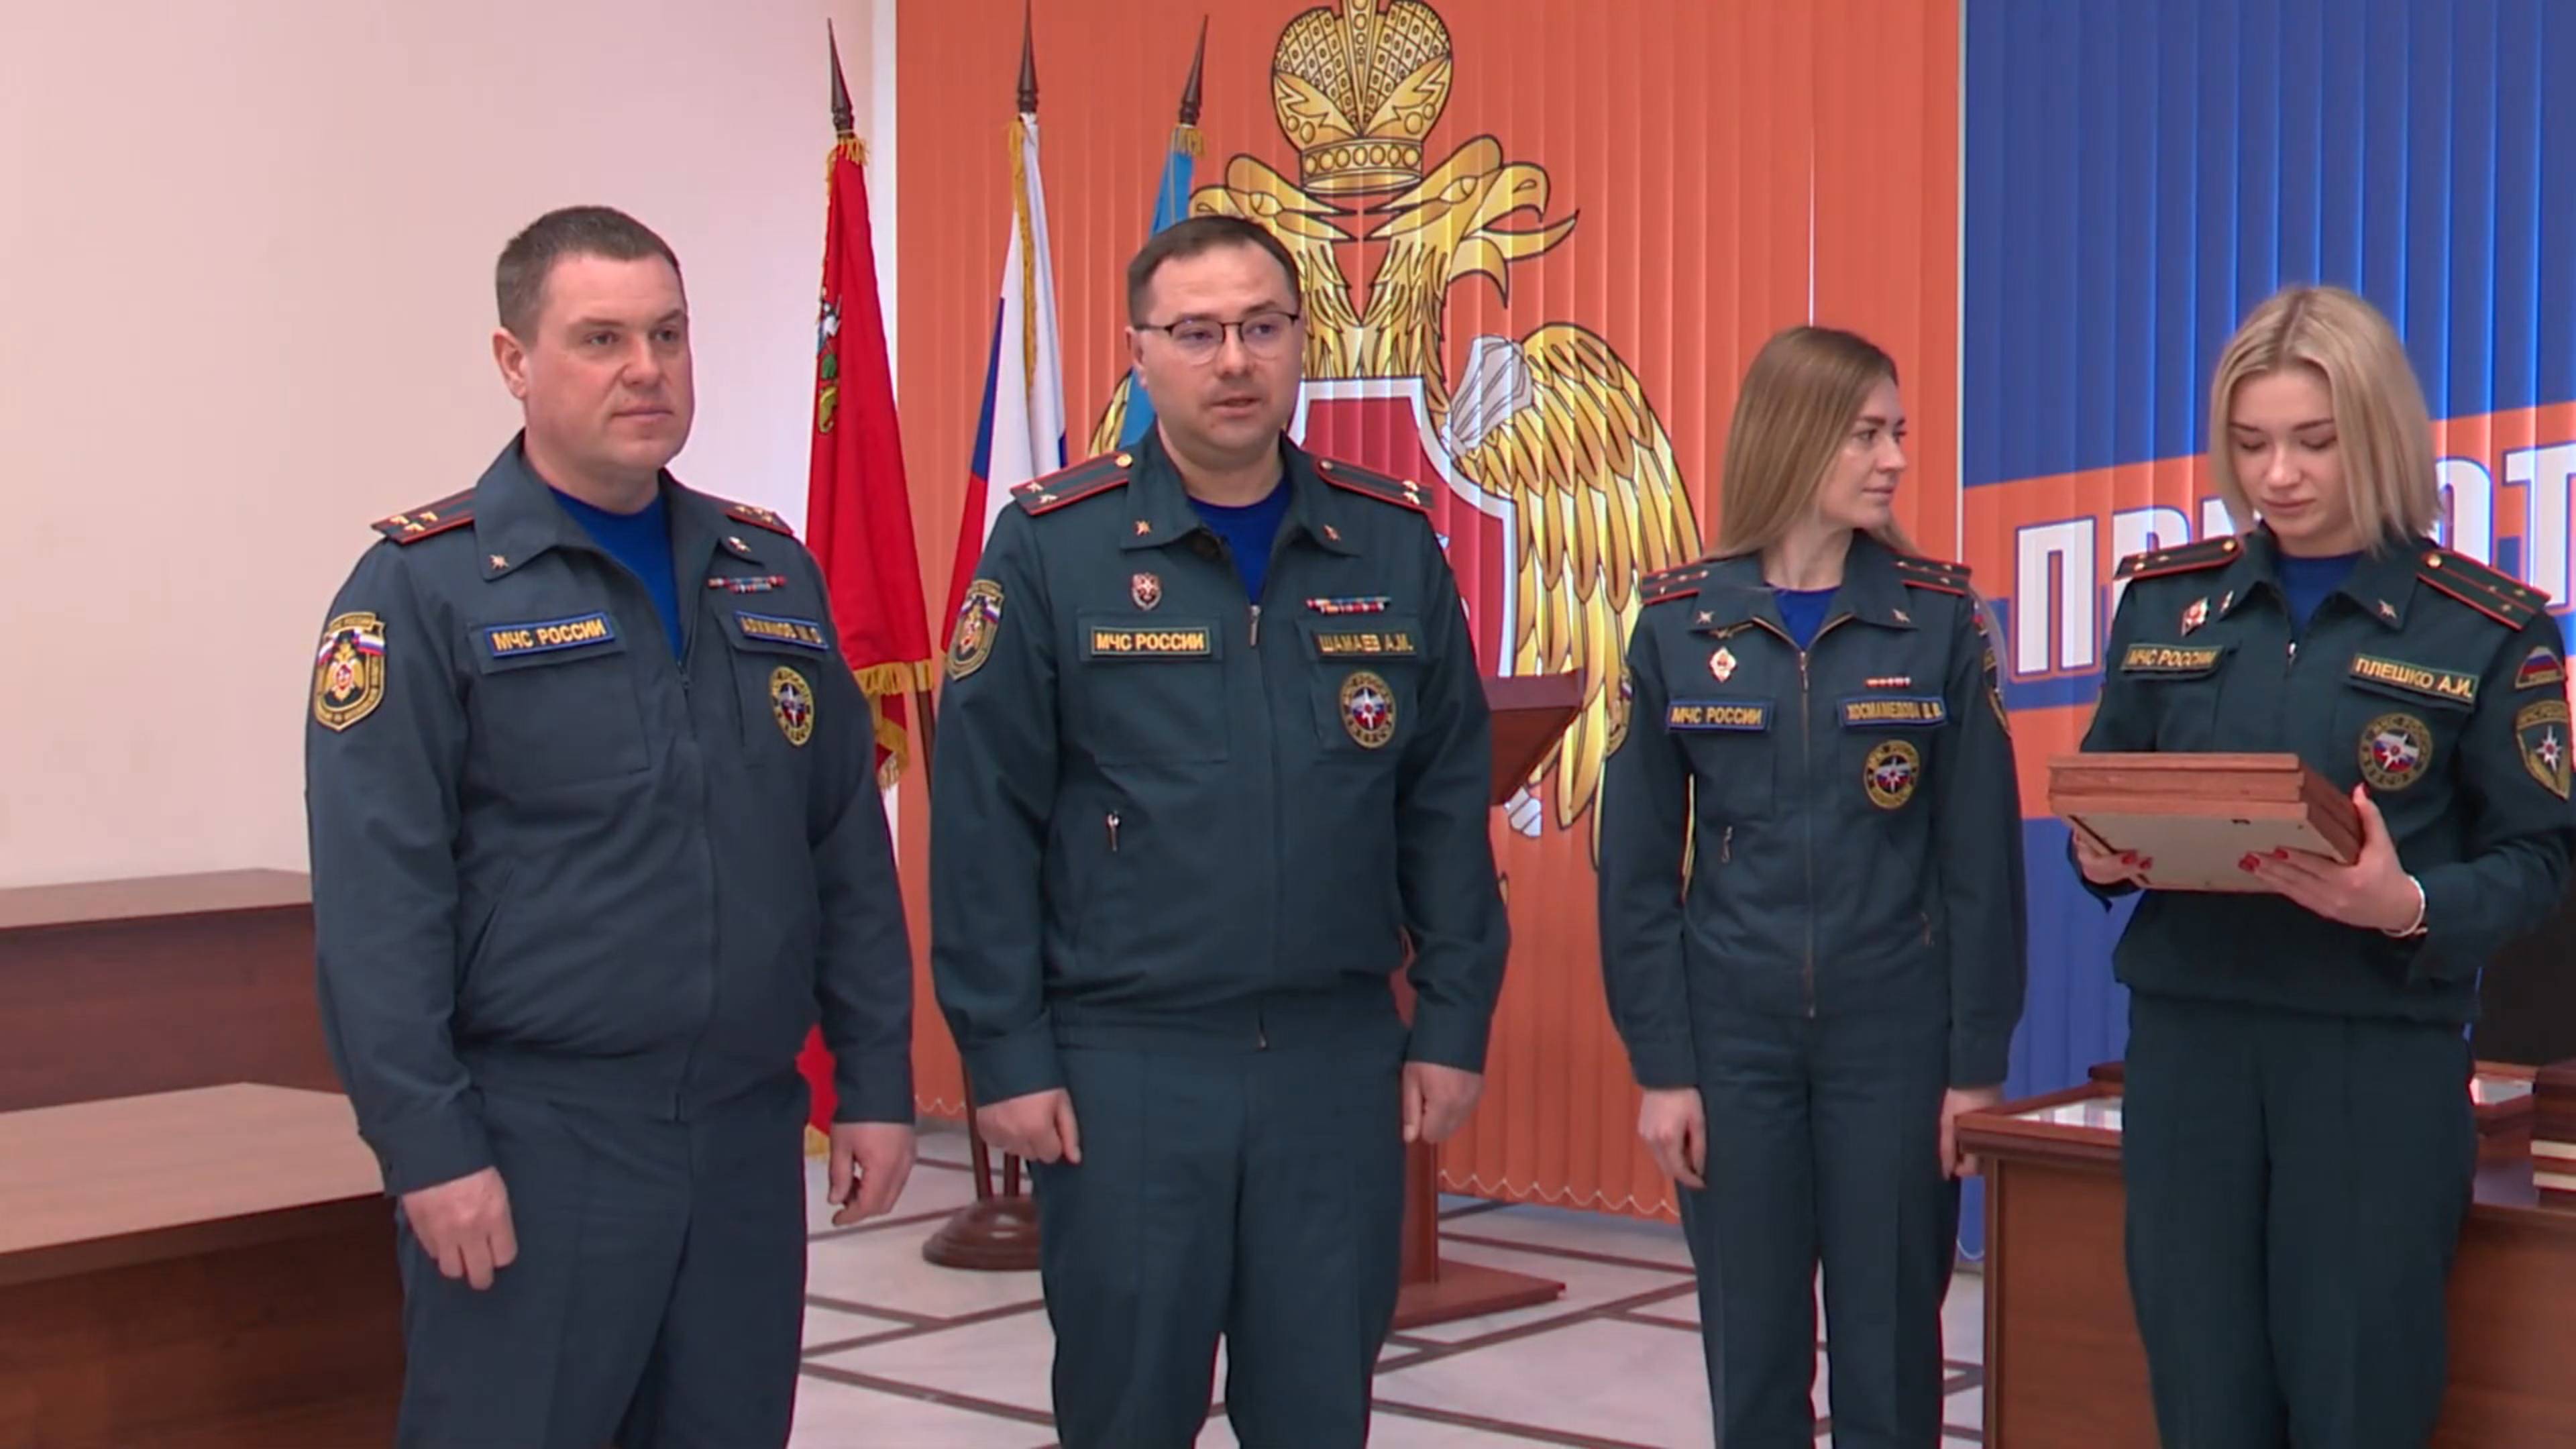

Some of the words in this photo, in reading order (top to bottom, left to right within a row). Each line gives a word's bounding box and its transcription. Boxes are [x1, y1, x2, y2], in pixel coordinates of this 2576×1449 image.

[492, 629, 534, 651] МЧС
[535, 618, 606, 645] РОССИИ
[1096, 632, 1132, 651] МЧС
[1134, 632, 1204, 651] РОССИИ
[1319, 634, 1382, 652] ШАМАЕВ
[2157, 649, 2216, 667] РОССИИ
[2355, 657, 2434, 688] ПЛЕШКО
[2437, 674, 2473, 698] А.И.
[1670, 706, 1702, 724] МЧС
[1705, 706, 1763, 725] РОССИИ
